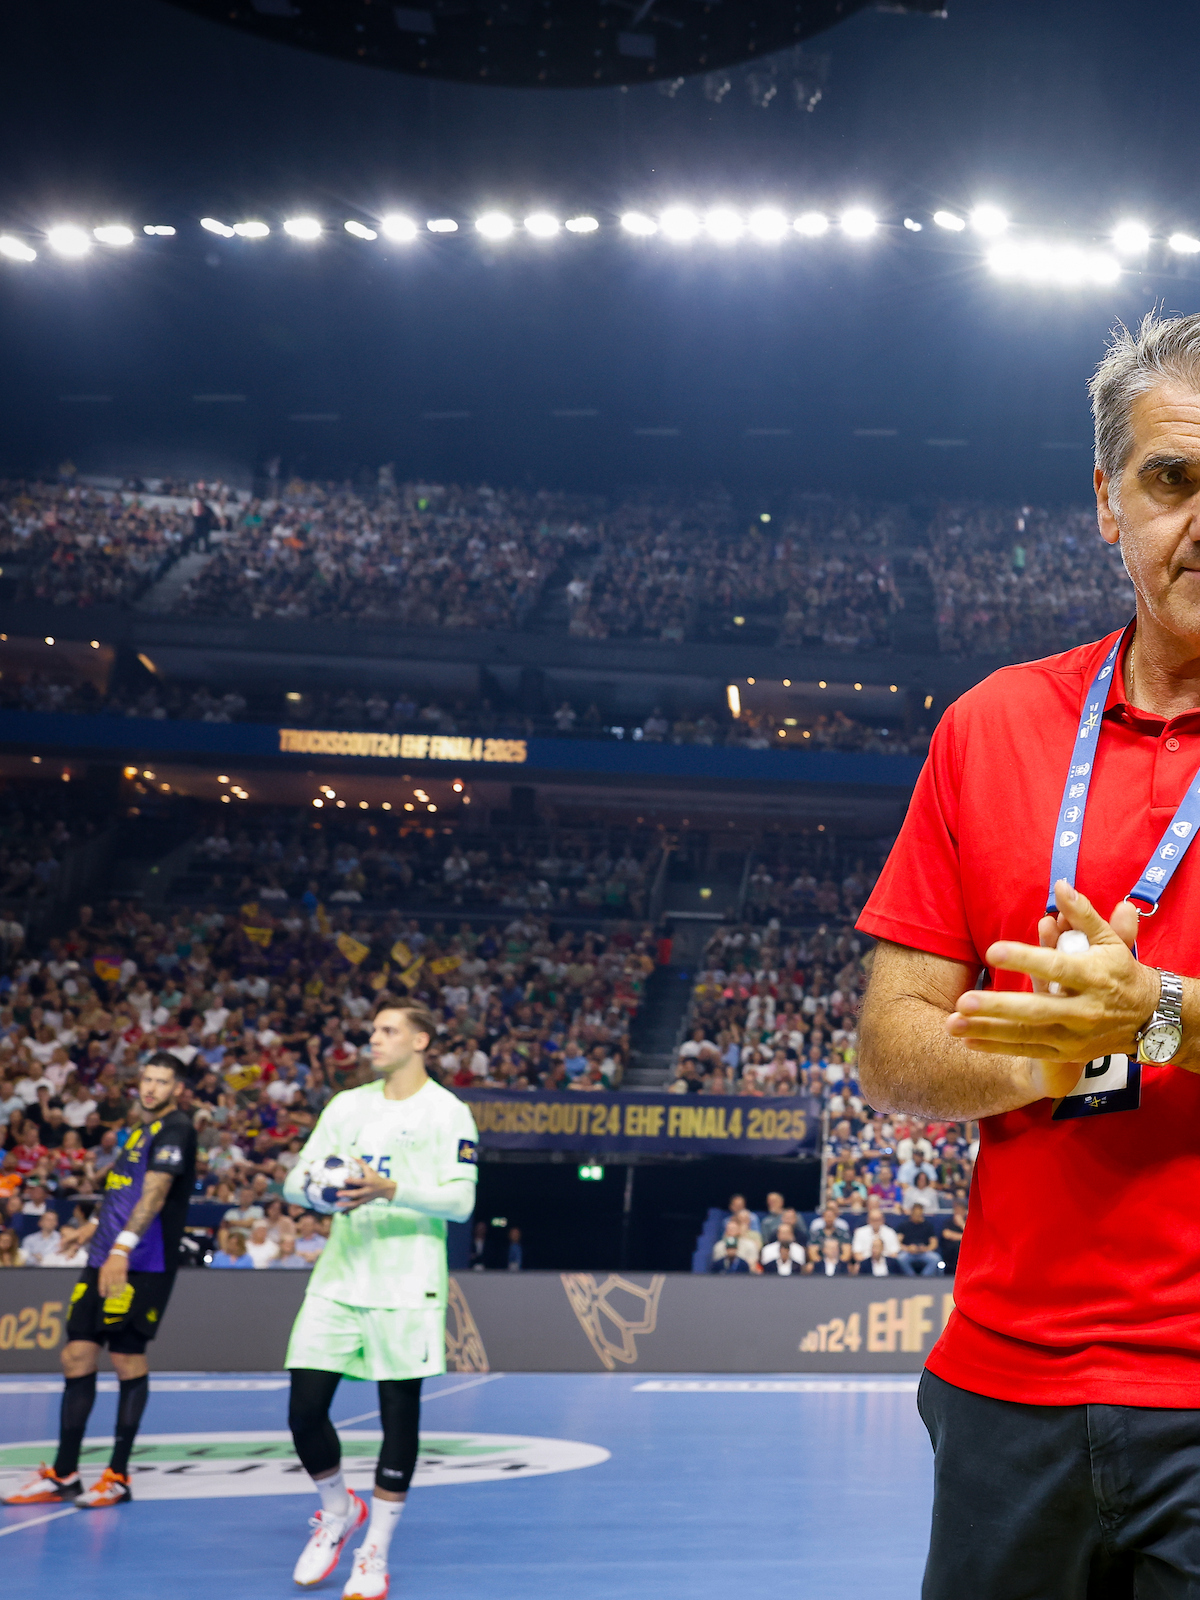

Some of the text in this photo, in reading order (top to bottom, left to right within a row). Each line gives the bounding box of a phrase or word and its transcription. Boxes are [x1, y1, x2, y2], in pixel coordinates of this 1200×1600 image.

[278, 729, 528, 763] TRUCKSCOUT24 EHF FINAL4 2025
[624, 1104, 665, 1137] EHF
[667, 1105, 743, 1139] FINAL4
[746, 1108, 807, 1141] 2025
[866, 1293, 934, 1353] EHF
